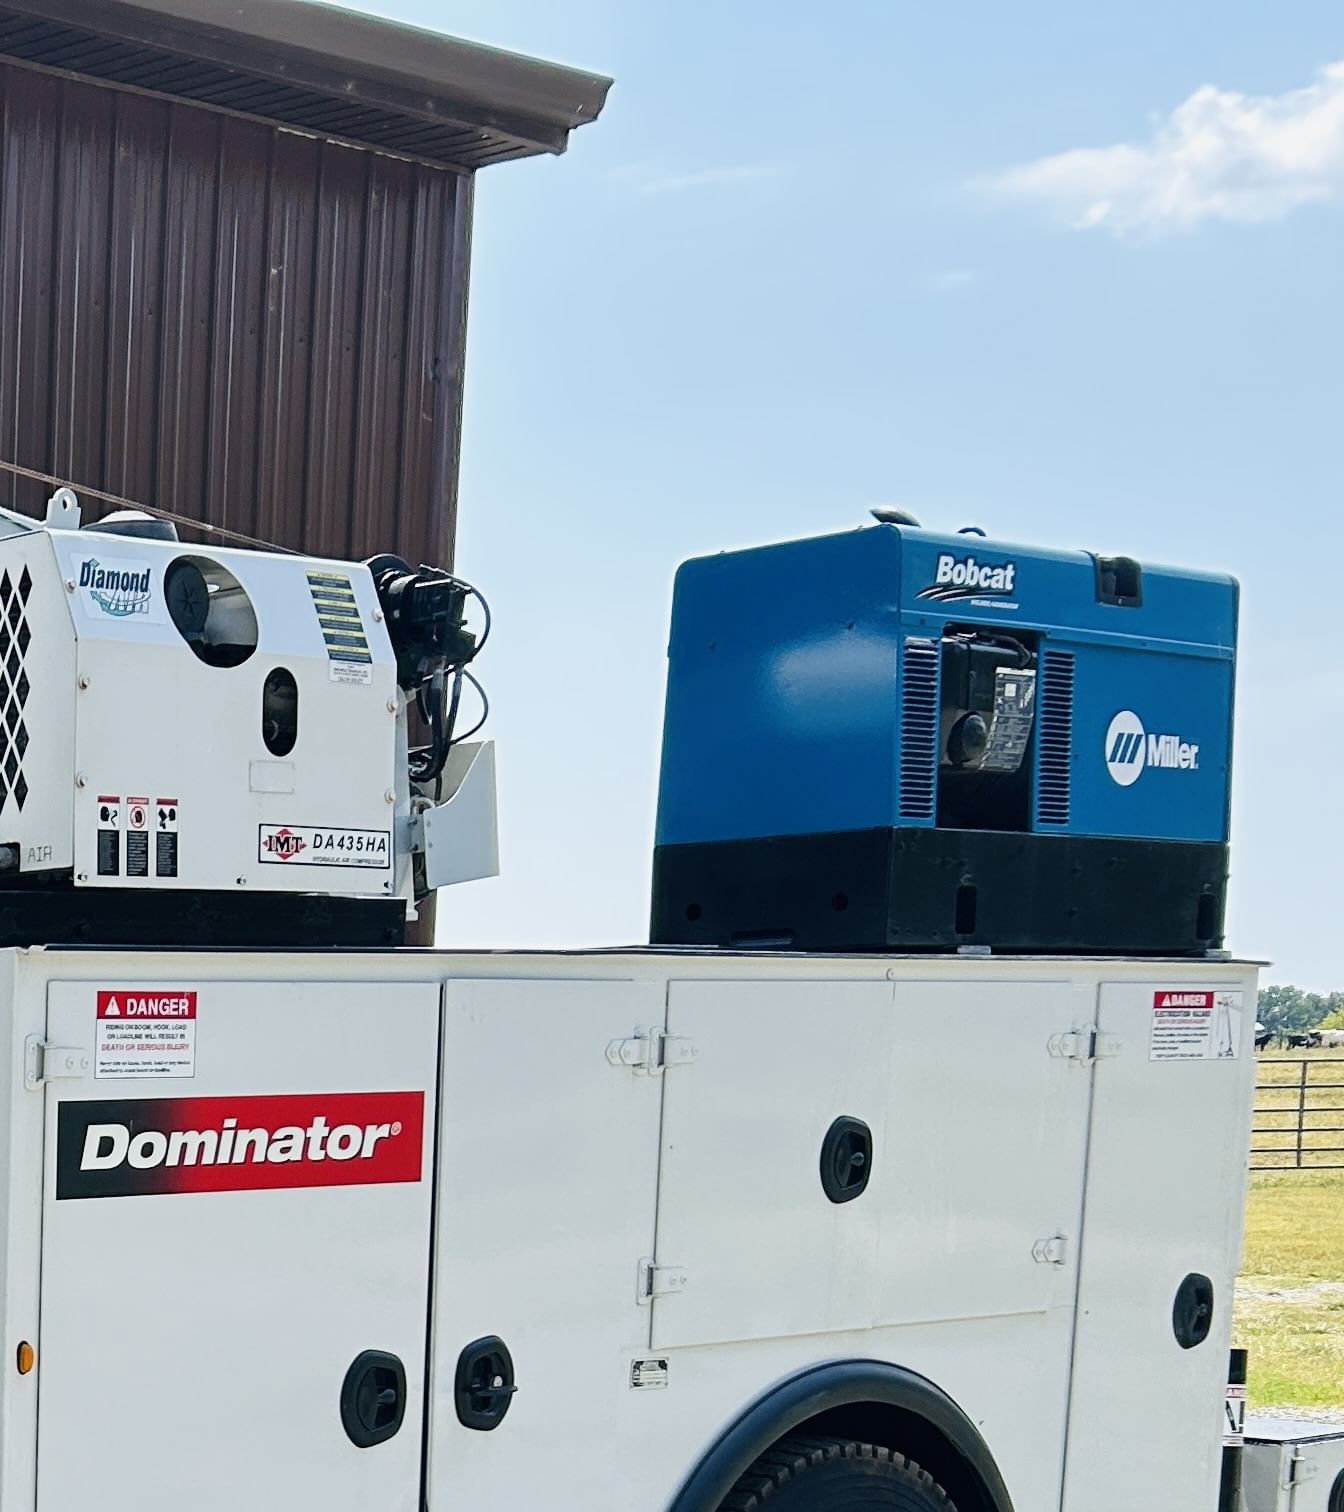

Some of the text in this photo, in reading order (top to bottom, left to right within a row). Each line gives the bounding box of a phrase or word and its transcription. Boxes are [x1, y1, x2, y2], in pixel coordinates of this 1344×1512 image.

[79, 559, 151, 593] Diamond
[935, 555, 1015, 590] Bobcat
[1146, 733, 1199, 769] Miller
[27, 845, 52, 863] AIR
[266, 833, 386, 853] IMT DA435HA
[126, 998, 189, 1016] DANGER
[80, 1116, 392, 1171] Dominator
